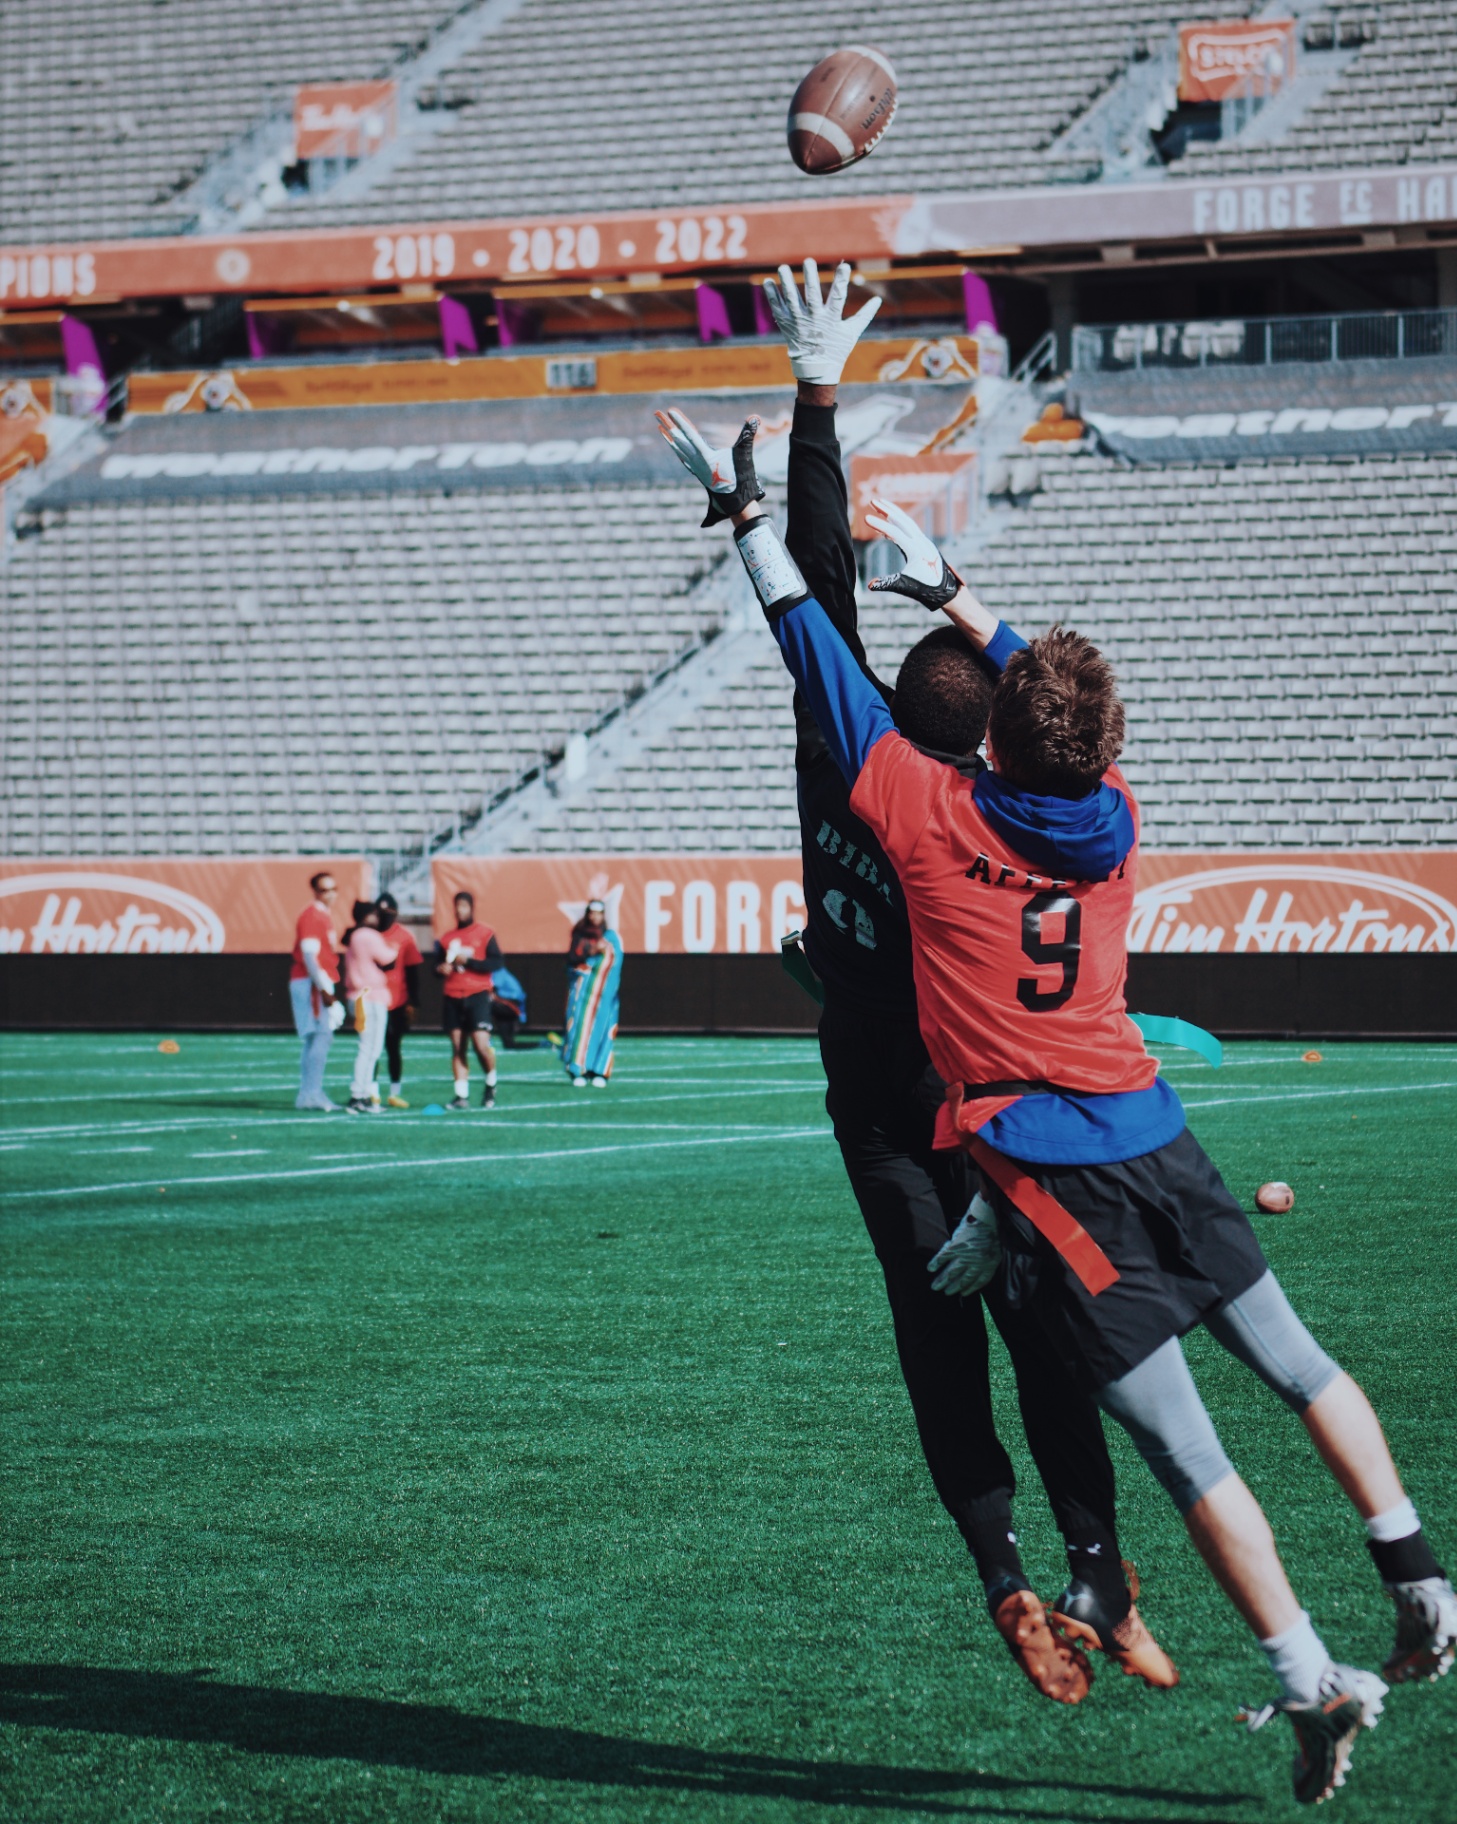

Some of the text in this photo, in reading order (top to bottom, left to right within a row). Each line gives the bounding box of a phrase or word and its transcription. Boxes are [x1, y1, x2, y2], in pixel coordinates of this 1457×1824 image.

[1193, 182, 1316, 234] FORGE
[1397, 175, 1457, 223] HA
[372, 232, 455, 281] 2019
[507, 224, 600, 274] 2020
[655, 214, 748, 265] 2022
[30, 893, 212, 953] Hortons
[1016, 890, 1082, 1013] 9
[1126, 886, 1450, 953] Tim Hortons
